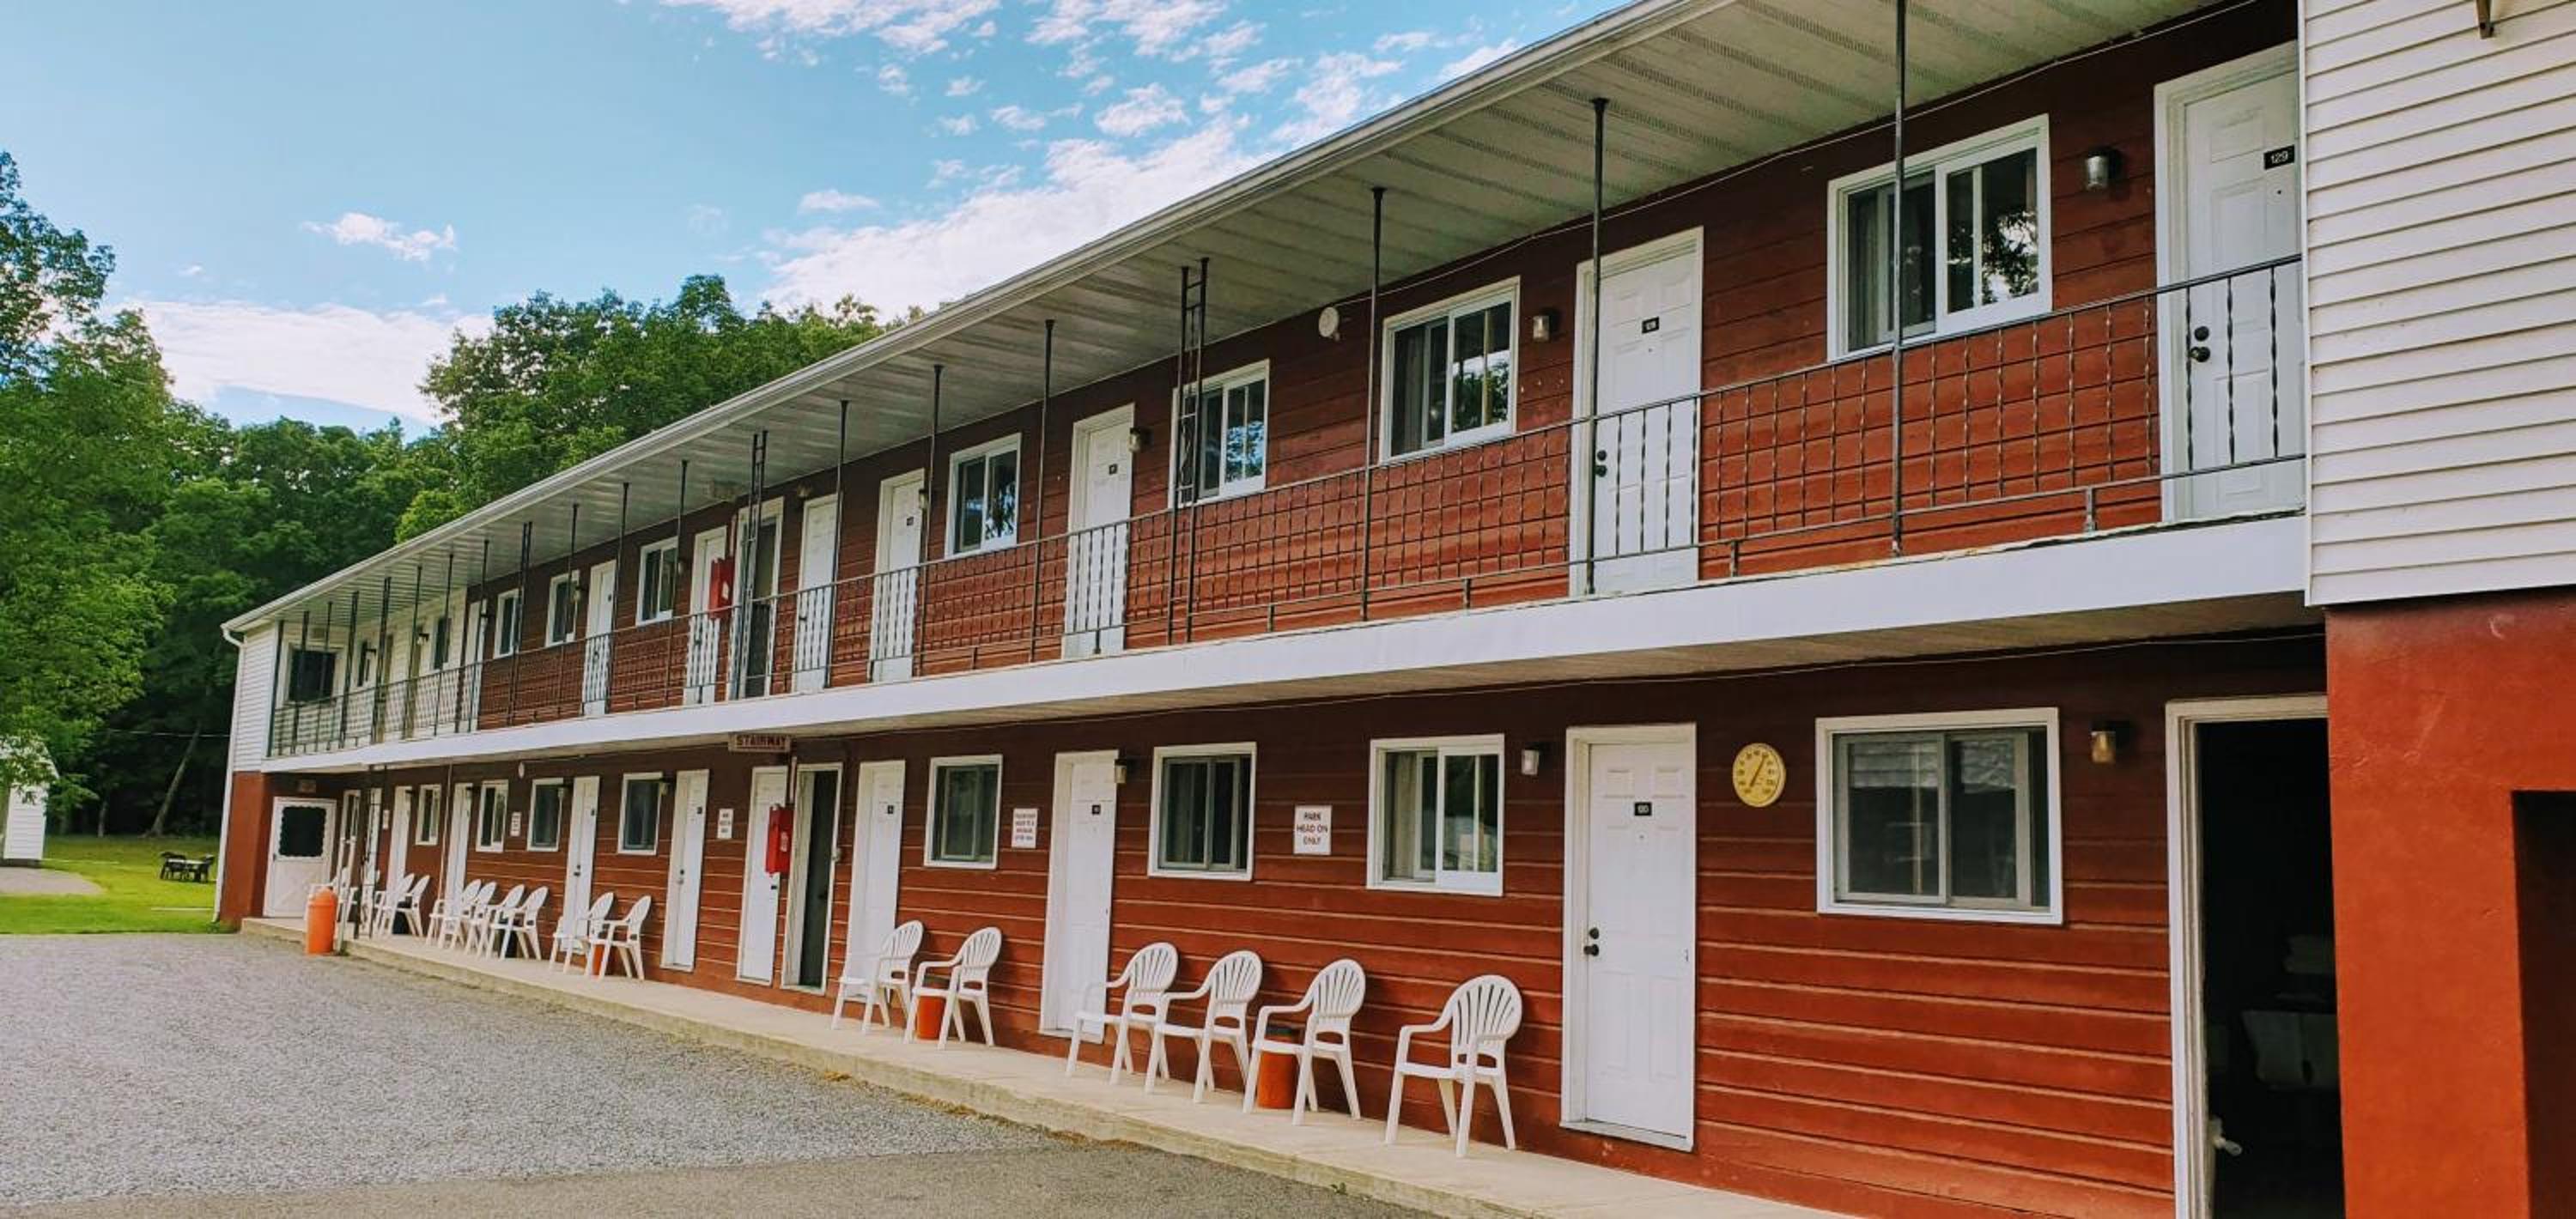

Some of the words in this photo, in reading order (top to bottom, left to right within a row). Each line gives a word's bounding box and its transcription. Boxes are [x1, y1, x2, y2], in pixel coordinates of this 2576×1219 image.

[2270, 150, 2289, 164] 129
[735, 735, 787, 748] STAIRWAY
[1303, 811, 1321, 821] PARK
[1297, 823, 1315, 833] HEAD
[1317, 823, 1328, 833] ON
[1303, 836, 1321, 846] ONLY
